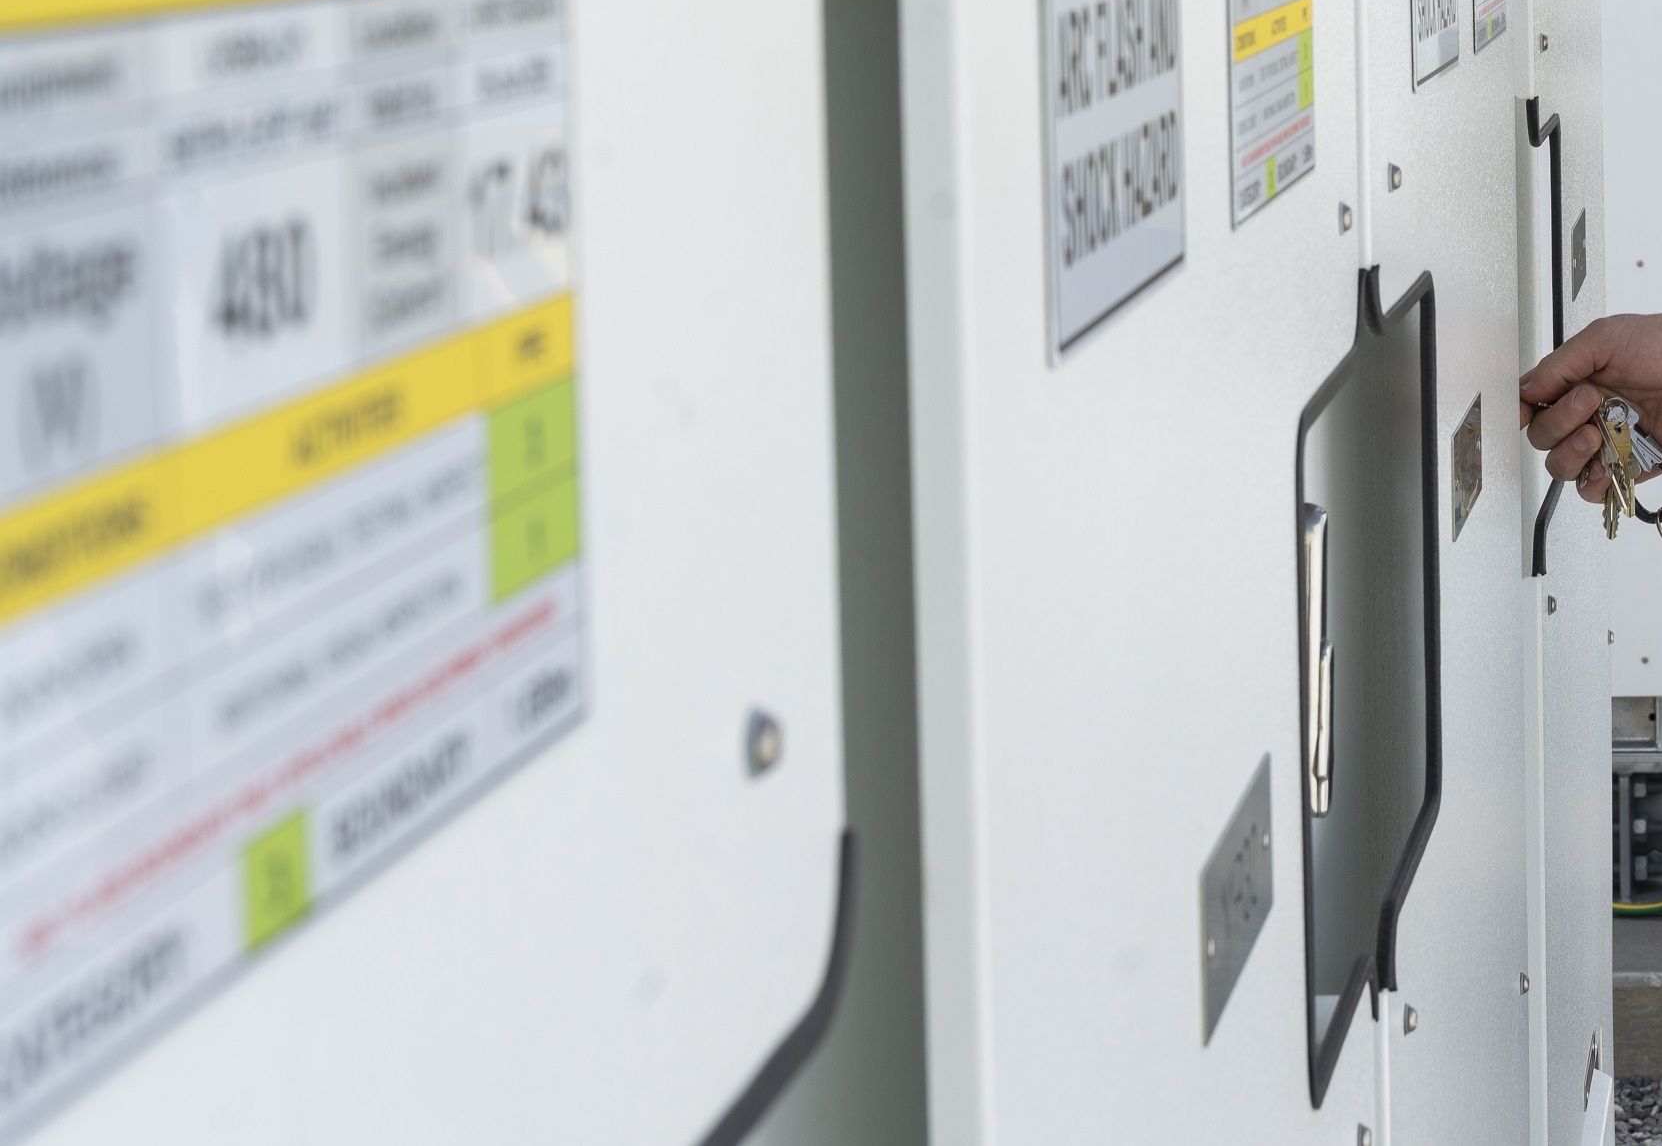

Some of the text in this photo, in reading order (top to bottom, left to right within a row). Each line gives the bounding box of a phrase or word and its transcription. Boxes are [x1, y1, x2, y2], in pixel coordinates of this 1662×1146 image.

[1057, 6, 1093, 118] ARC
[1060, 140, 1120, 267] SHOCK
[1121, 110, 1179, 231] HAZARD
